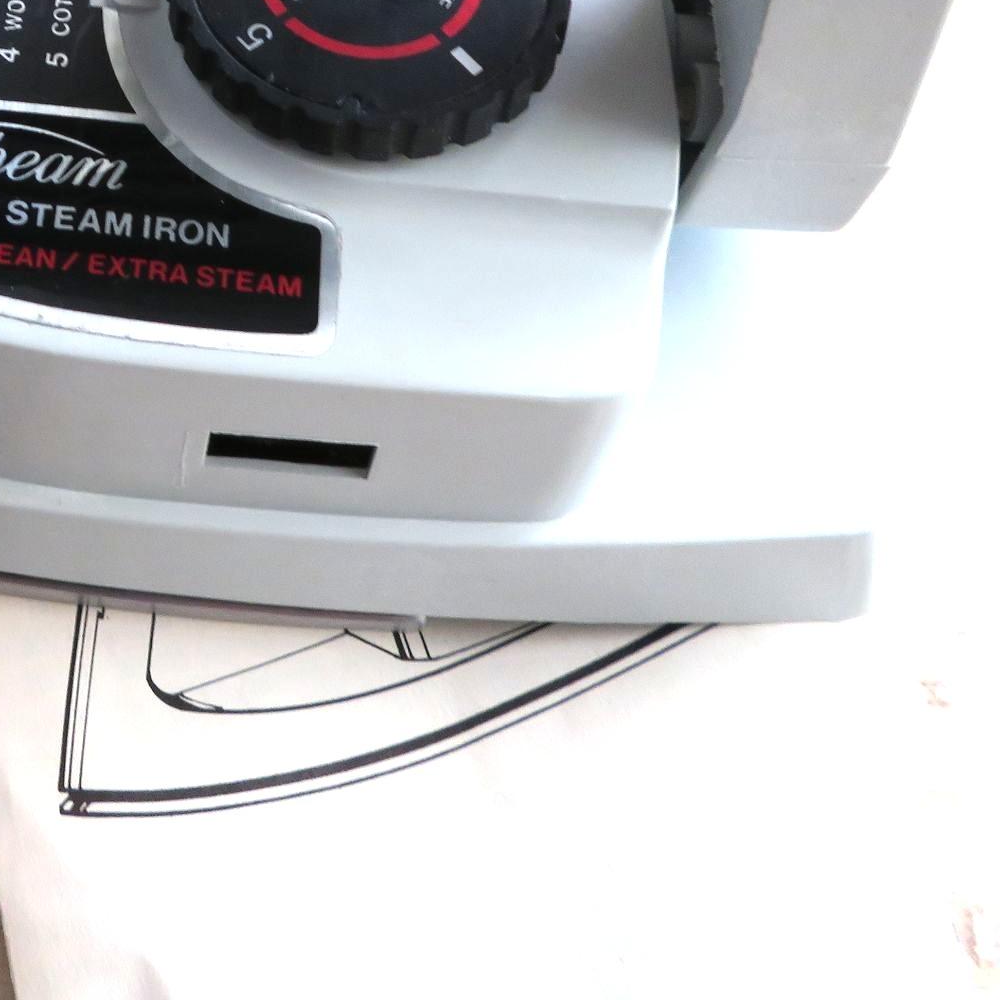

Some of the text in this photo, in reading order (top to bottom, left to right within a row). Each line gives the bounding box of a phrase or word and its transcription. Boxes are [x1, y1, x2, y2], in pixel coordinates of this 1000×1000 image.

[236, 22, 273, 52] 5
[45, 51, 69, 68] 5
[5, 200, 132, 238] STEAM
[143, 216, 230, 248] IRON
[87, 254, 185, 284] EXTRA
[195, 268, 303, 298] STEAM
